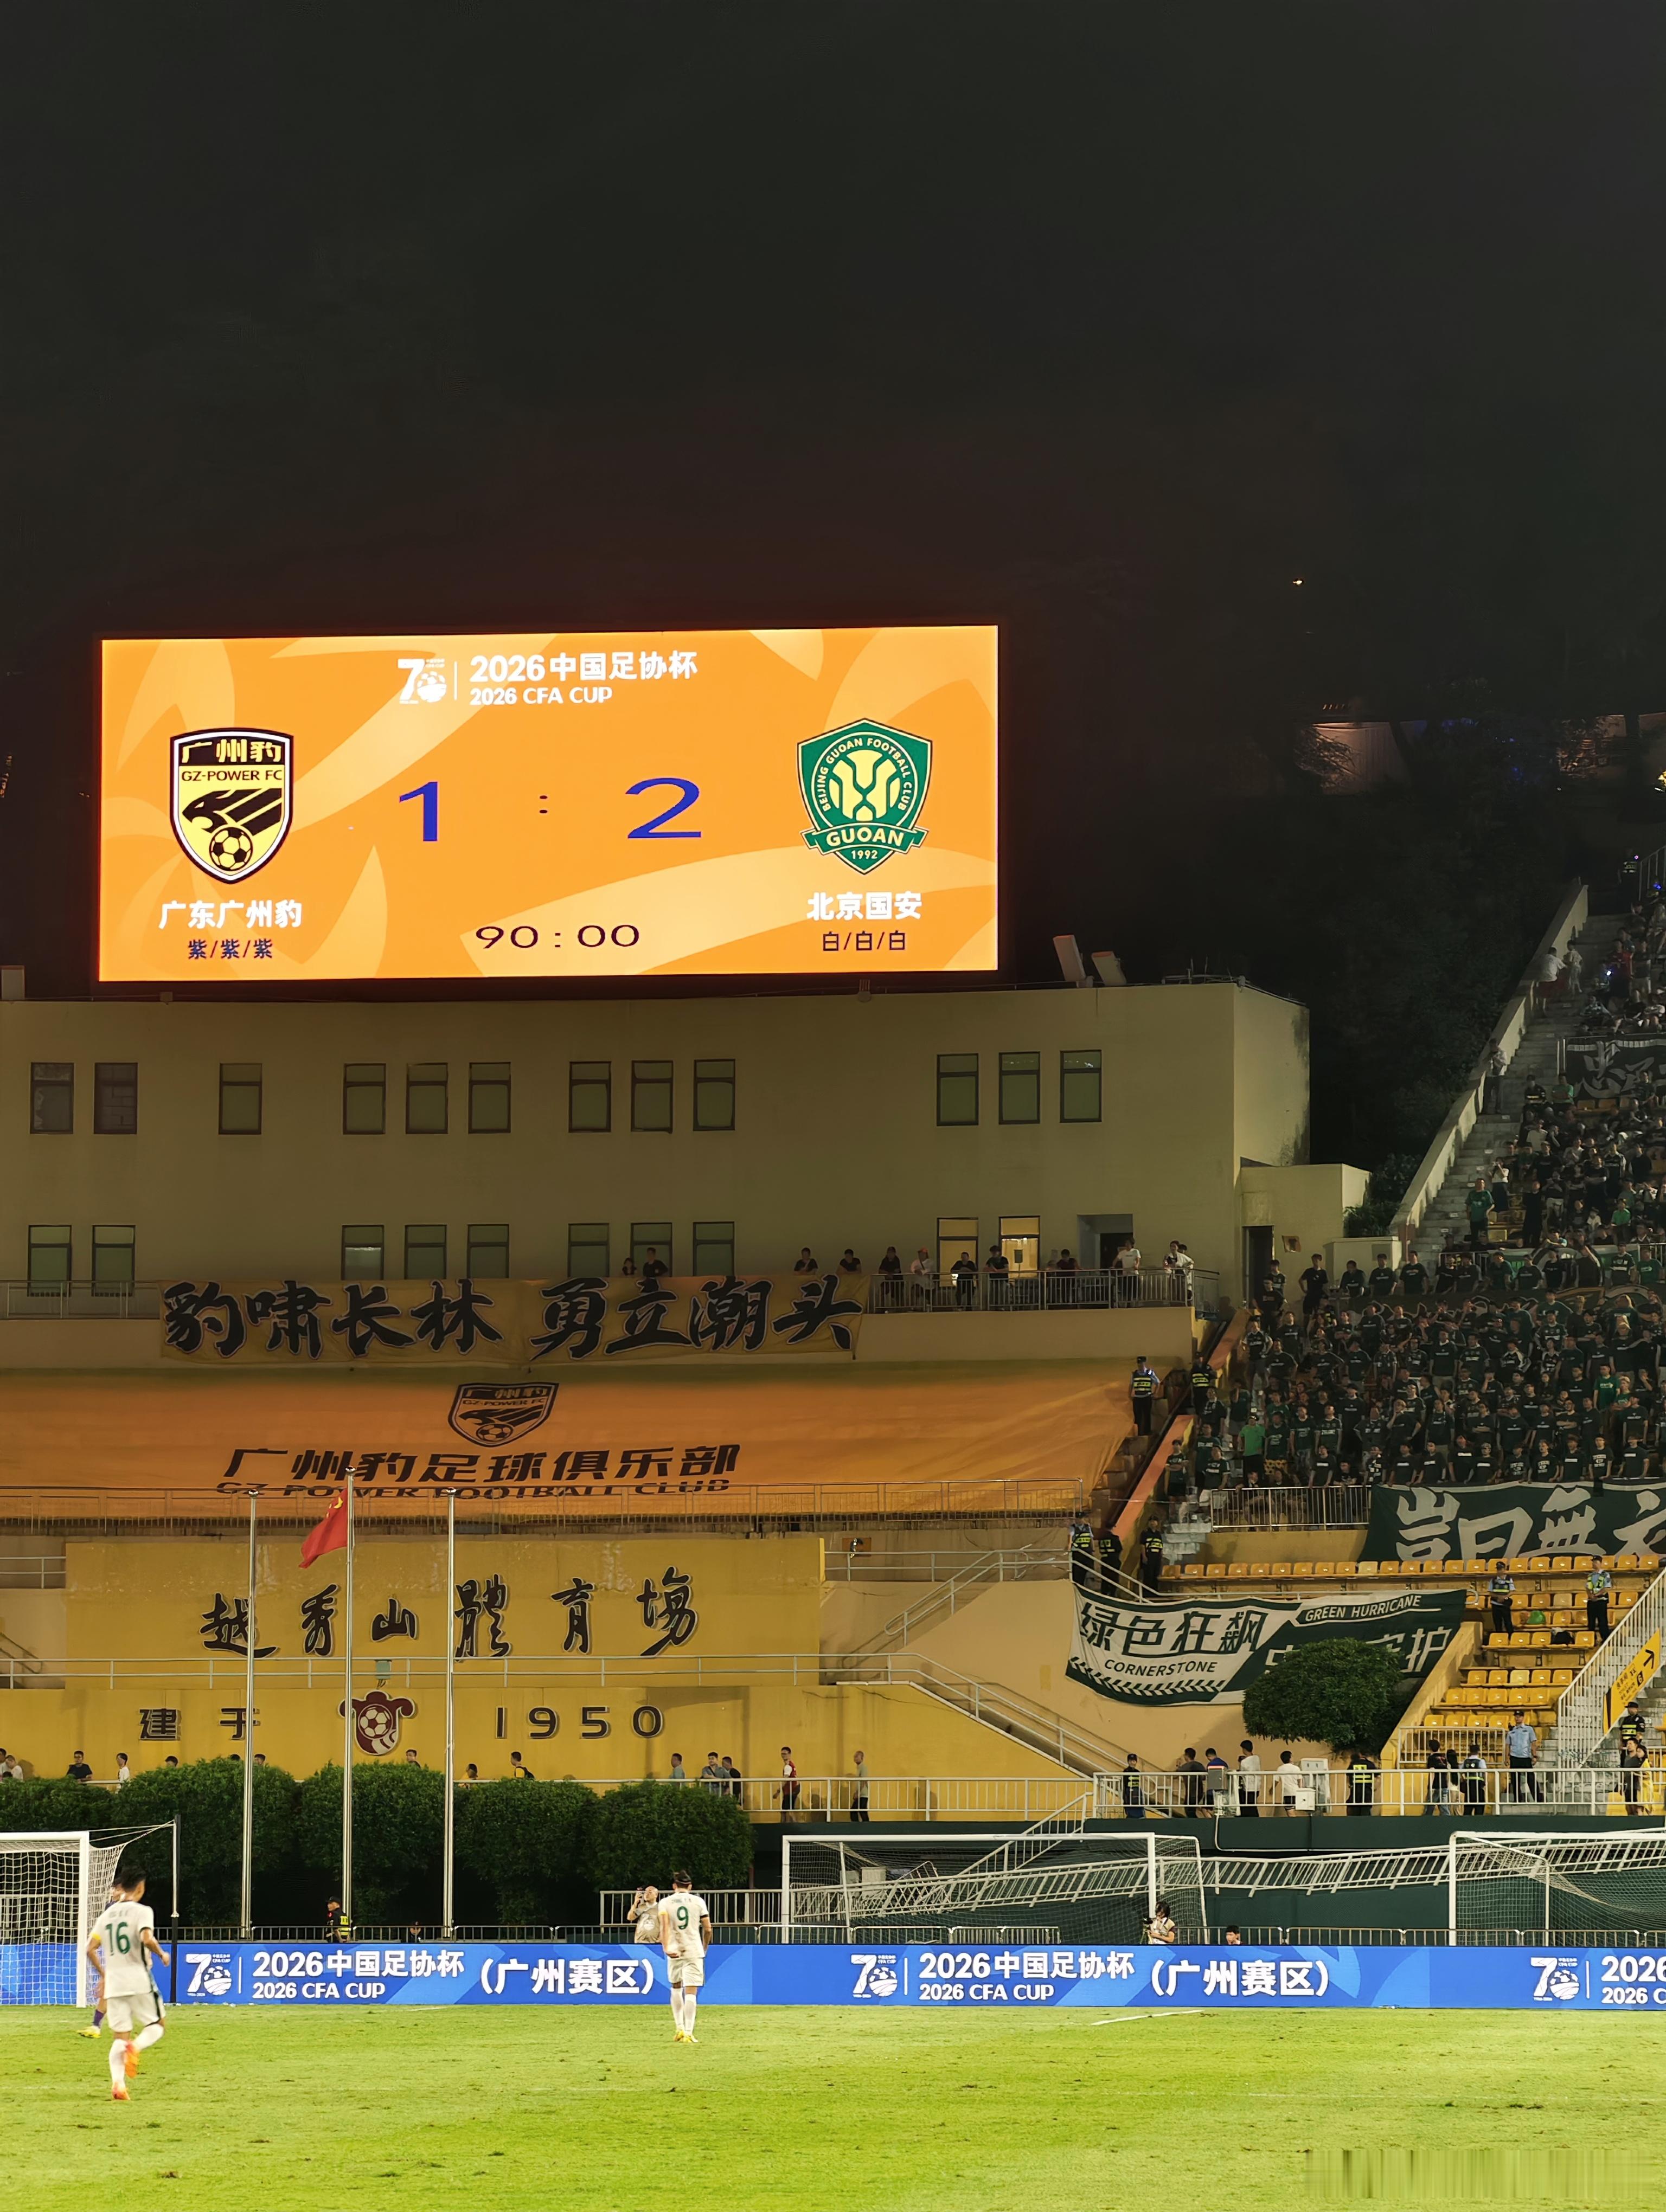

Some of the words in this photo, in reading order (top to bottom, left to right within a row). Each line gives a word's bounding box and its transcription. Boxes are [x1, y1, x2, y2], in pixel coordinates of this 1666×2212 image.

[470, 651, 698, 682] 2026中国足协杯
[470, 687, 517, 705] 2026
[523, 687, 563, 704] CFA
[569, 686, 613, 703] CUP
[182, 738, 281, 763] 广州豹
[181, 769, 260, 782] GZ-POWER
[265, 769, 282, 780] FC
[817, 766, 832, 812] BEIJING
[825, 738, 863, 764] GUOAN
[867, 738, 911, 779] FOOTBALL
[898, 782, 912, 811] CLUB
[399, 781, 438, 842] 1
[625, 777, 702, 839] 2
[826, 827, 904, 847] GUOAN
[851, 850, 878, 860] 1992
[159, 899, 302, 930] 广东广州豹
[806, 890, 922, 921] 北京国安
[188, 938, 273, 960] 紫/紫/紫
[822, 930, 906, 952] 白/白/白
[223, 1444, 741, 1483] 广州豹足球俱乐部
[636, 1479, 730, 1495] CLUB
[1305, 1606, 1346, 1622] GREEN
[1350, 1596, 1422, 1618] HURRICANE
[1104, 1659, 1218, 1677] CORNERSTONE
[496, 1706, 664, 1739] 1950
[677, 1906, 689, 1930] 9
[105, 1922, 131, 1956] 16
[252, 1950, 465, 1978] 2026中国足协杯
[919, 1951, 1135, 1979] 2026中国足协杯
[252, 1982, 297, 1999] 2026
[302, 1982, 340, 1998] CFA
[345, 1982, 385, 1999] CUP
[919, 1983, 964, 2001] 2026
[969, 1983, 1008, 2001] CFA
[1013, 1984, 1055, 2001] CUP
[1601, 1987, 1648, 2004] 2026
